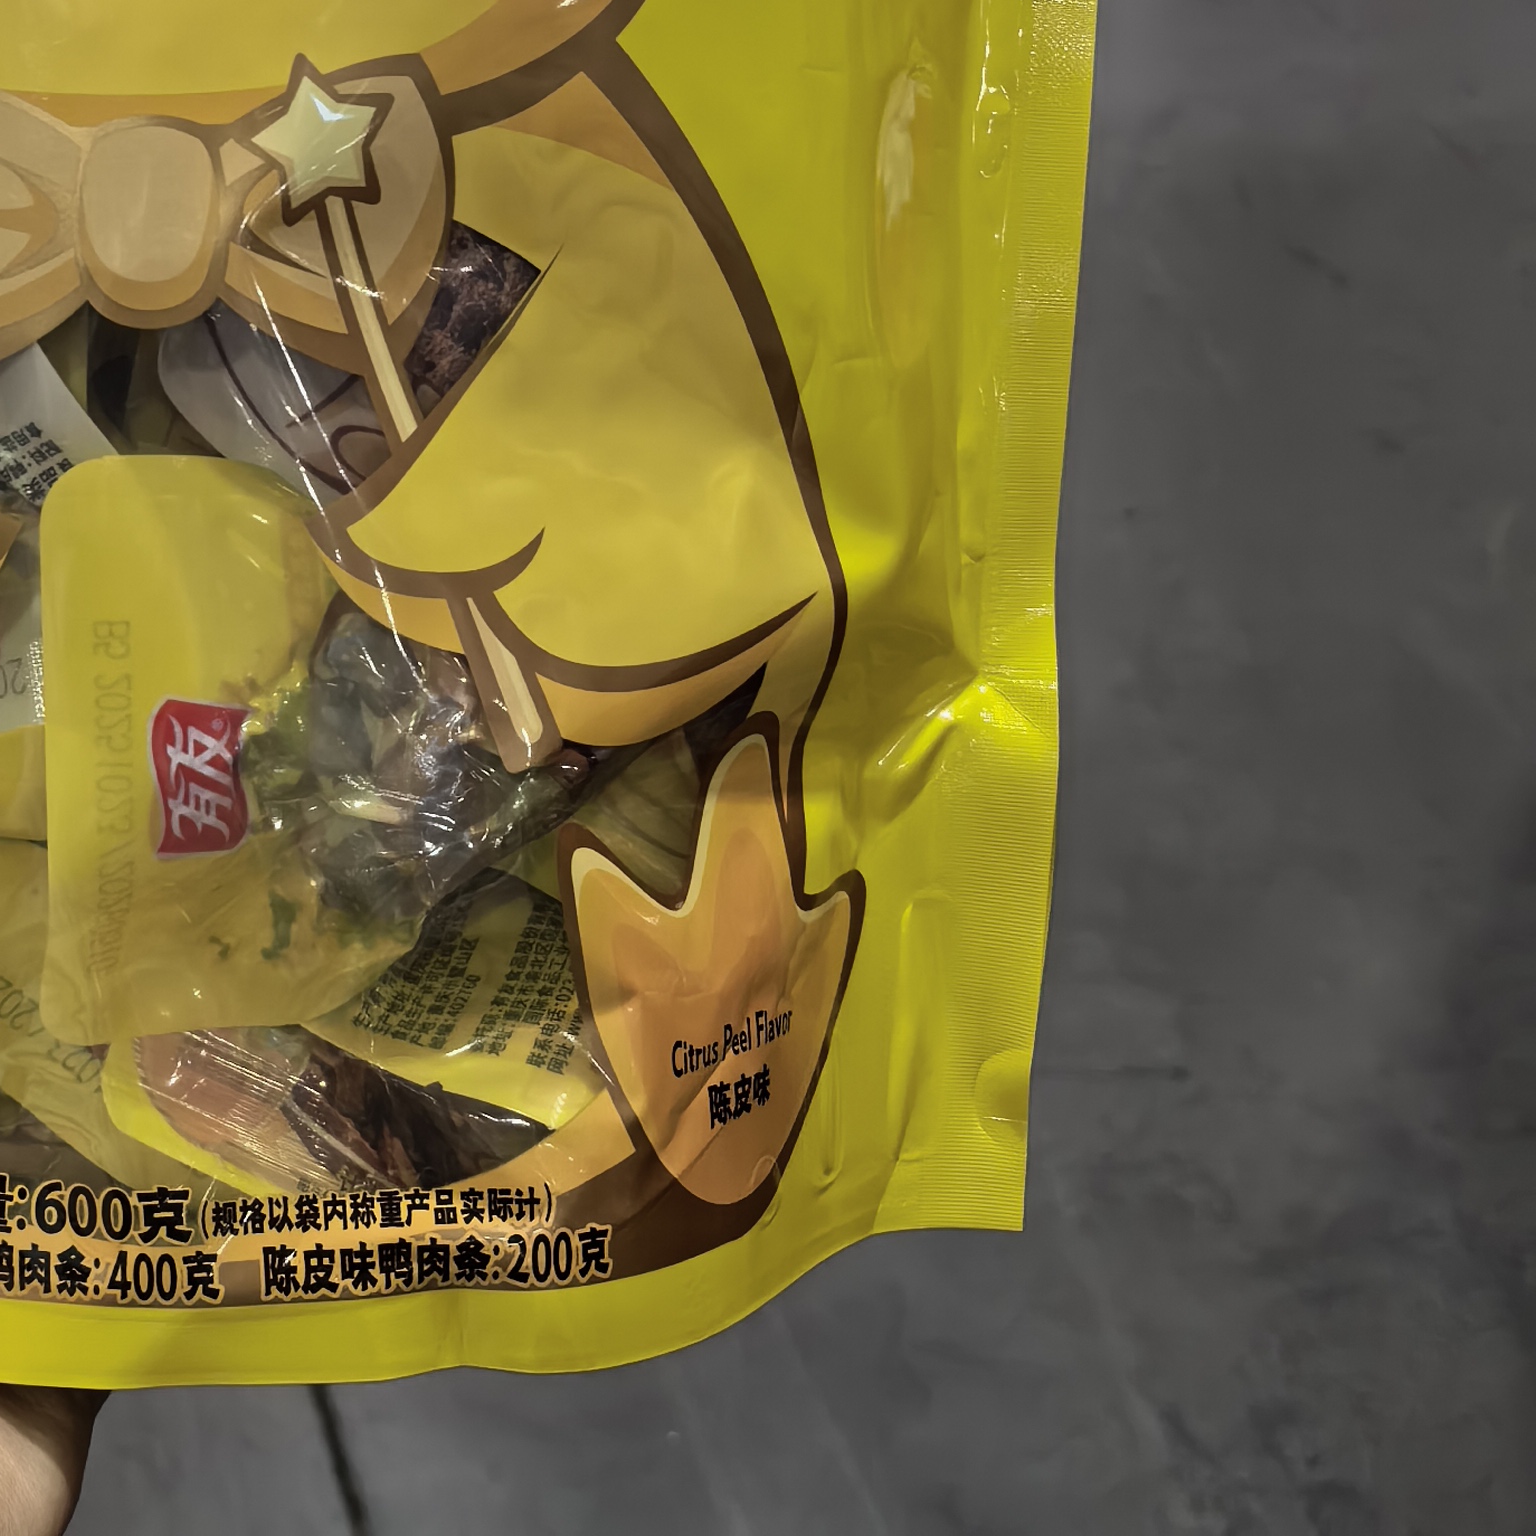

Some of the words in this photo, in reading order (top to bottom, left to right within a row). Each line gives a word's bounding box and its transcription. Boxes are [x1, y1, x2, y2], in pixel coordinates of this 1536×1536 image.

[672, 1040, 719, 1078] Citrus
[721, 1016, 752, 1061] Peel
[755, 1010, 793, 1048] Flavor
[707, 1063, 771, 1130] 陈皮味
